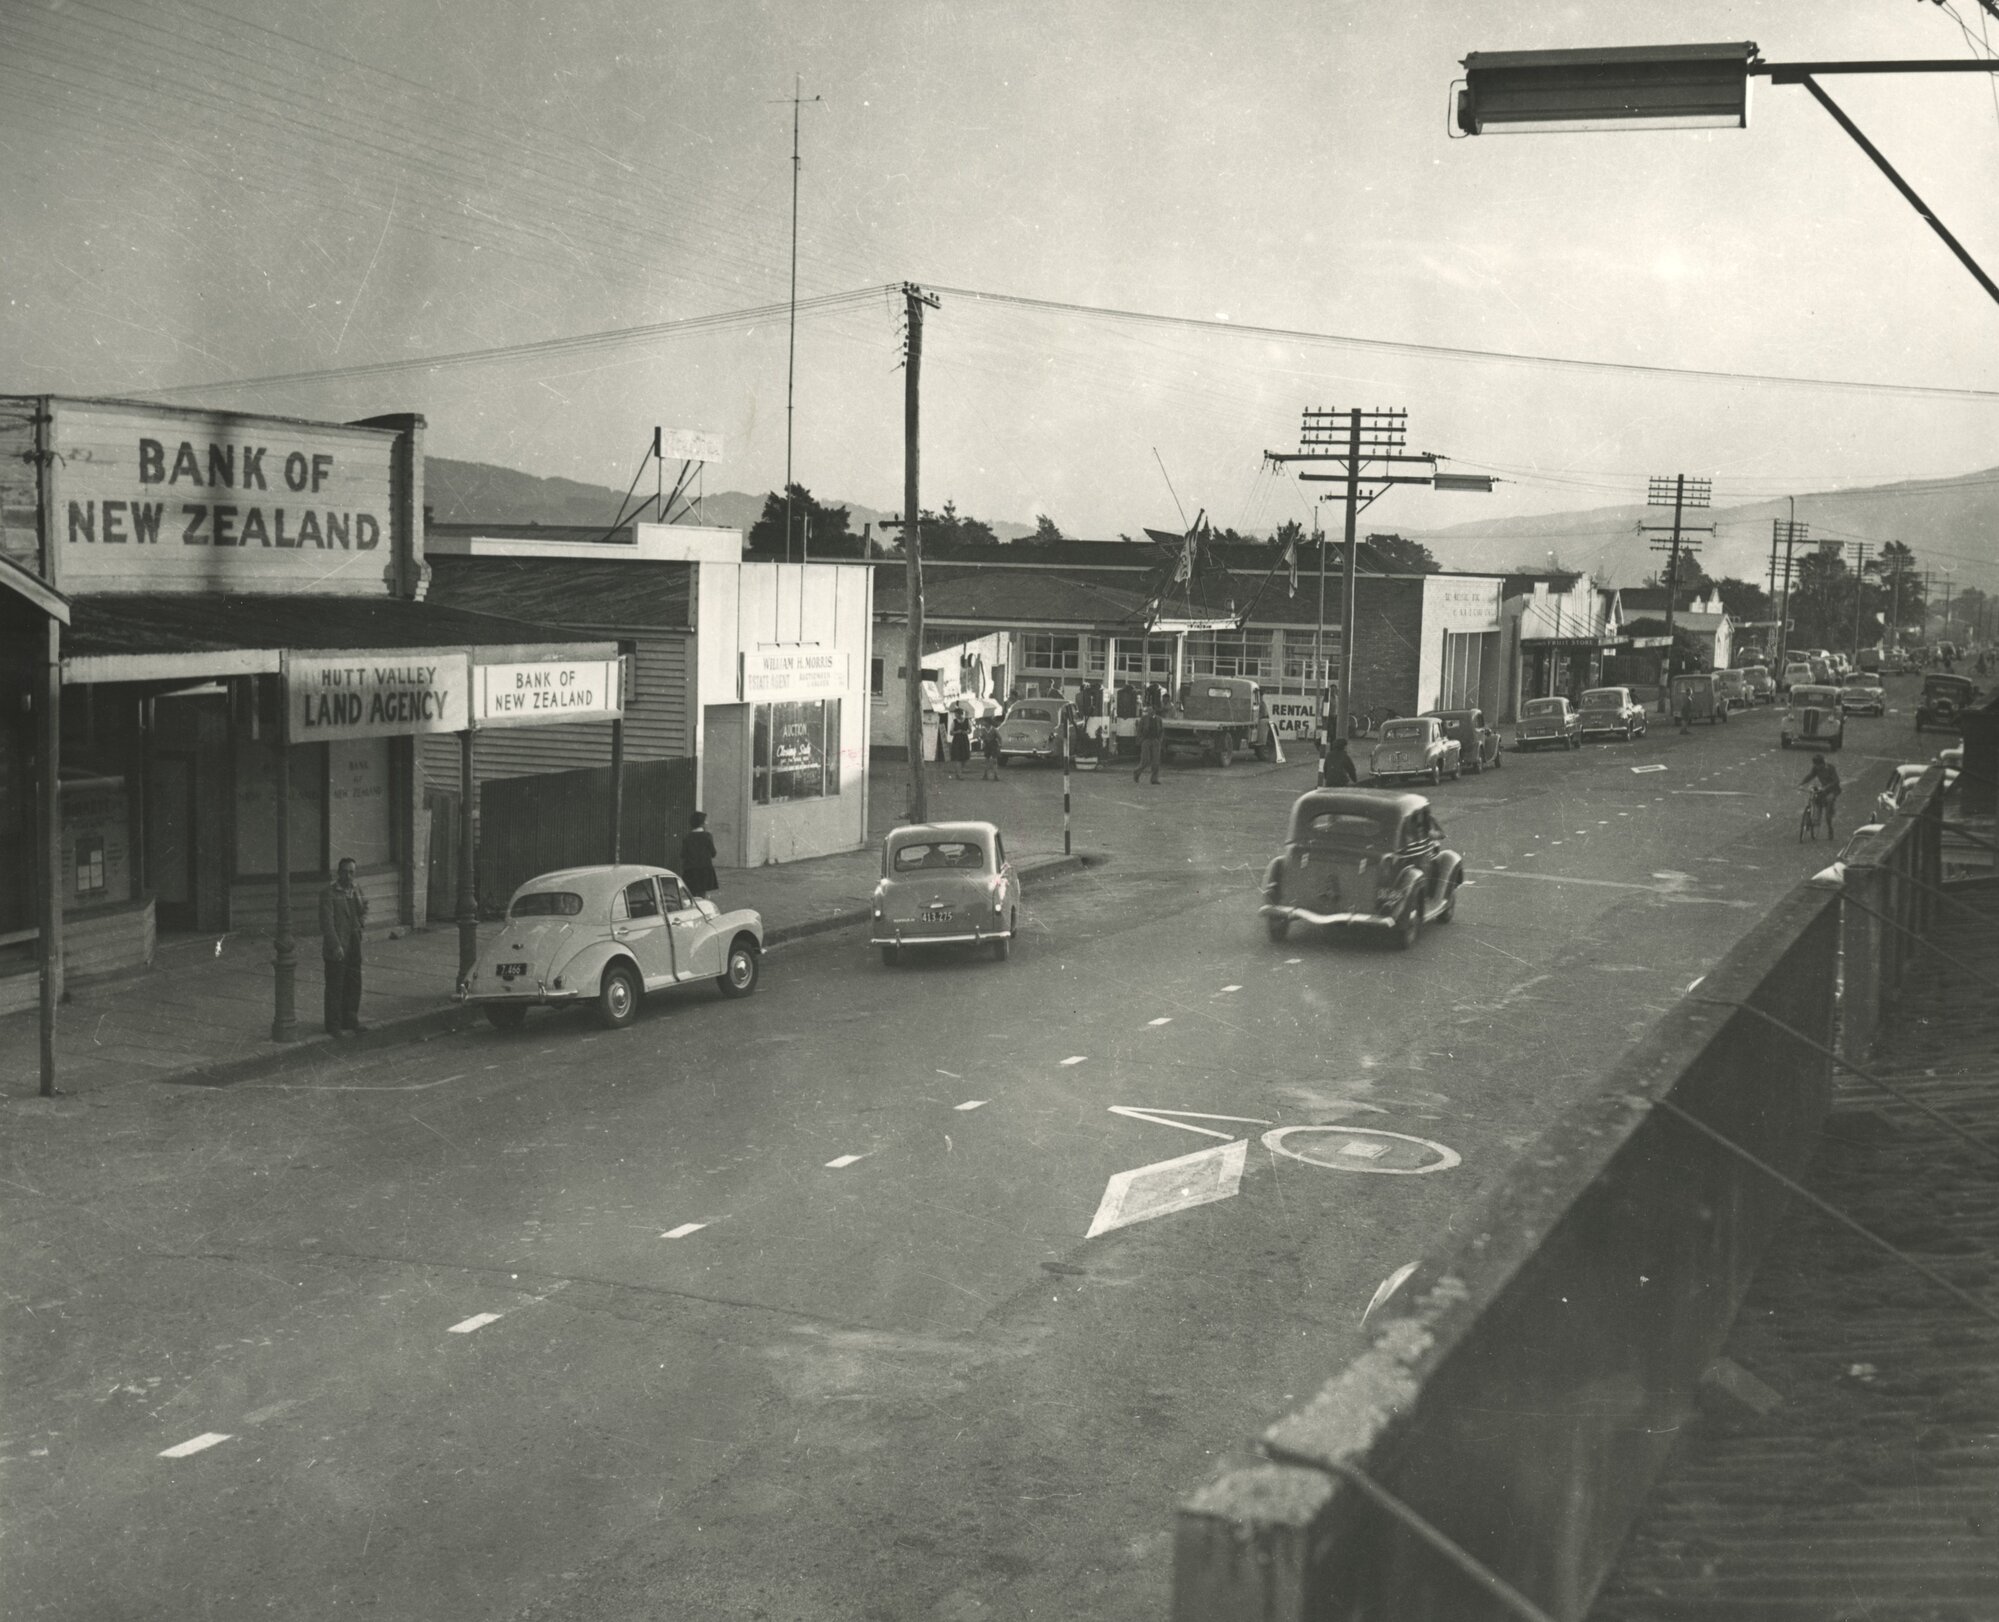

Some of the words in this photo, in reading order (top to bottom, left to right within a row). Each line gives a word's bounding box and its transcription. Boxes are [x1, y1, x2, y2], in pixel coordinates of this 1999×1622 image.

[138, 437, 268, 491] BANK
[284, 451, 334, 493] OF
[67, 500, 164, 545] NEW
[181, 503, 381, 551] ZEALAND
[321, 667, 366, 687] HUTT
[374, 666, 437, 685] VALLEY
[515, 672, 552, 689] BANK
[559, 670, 577, 687] OF
[304, 692, 363, 727] LAND
[369, 690, 448, 724] AGENCY
[495, 692, 526, 712] NEW
[532, 690, 593, 709] ZEALAND
[1272, 703, 1316, 717] RENTAL
[1279, 719, 1310, 731] CARS
